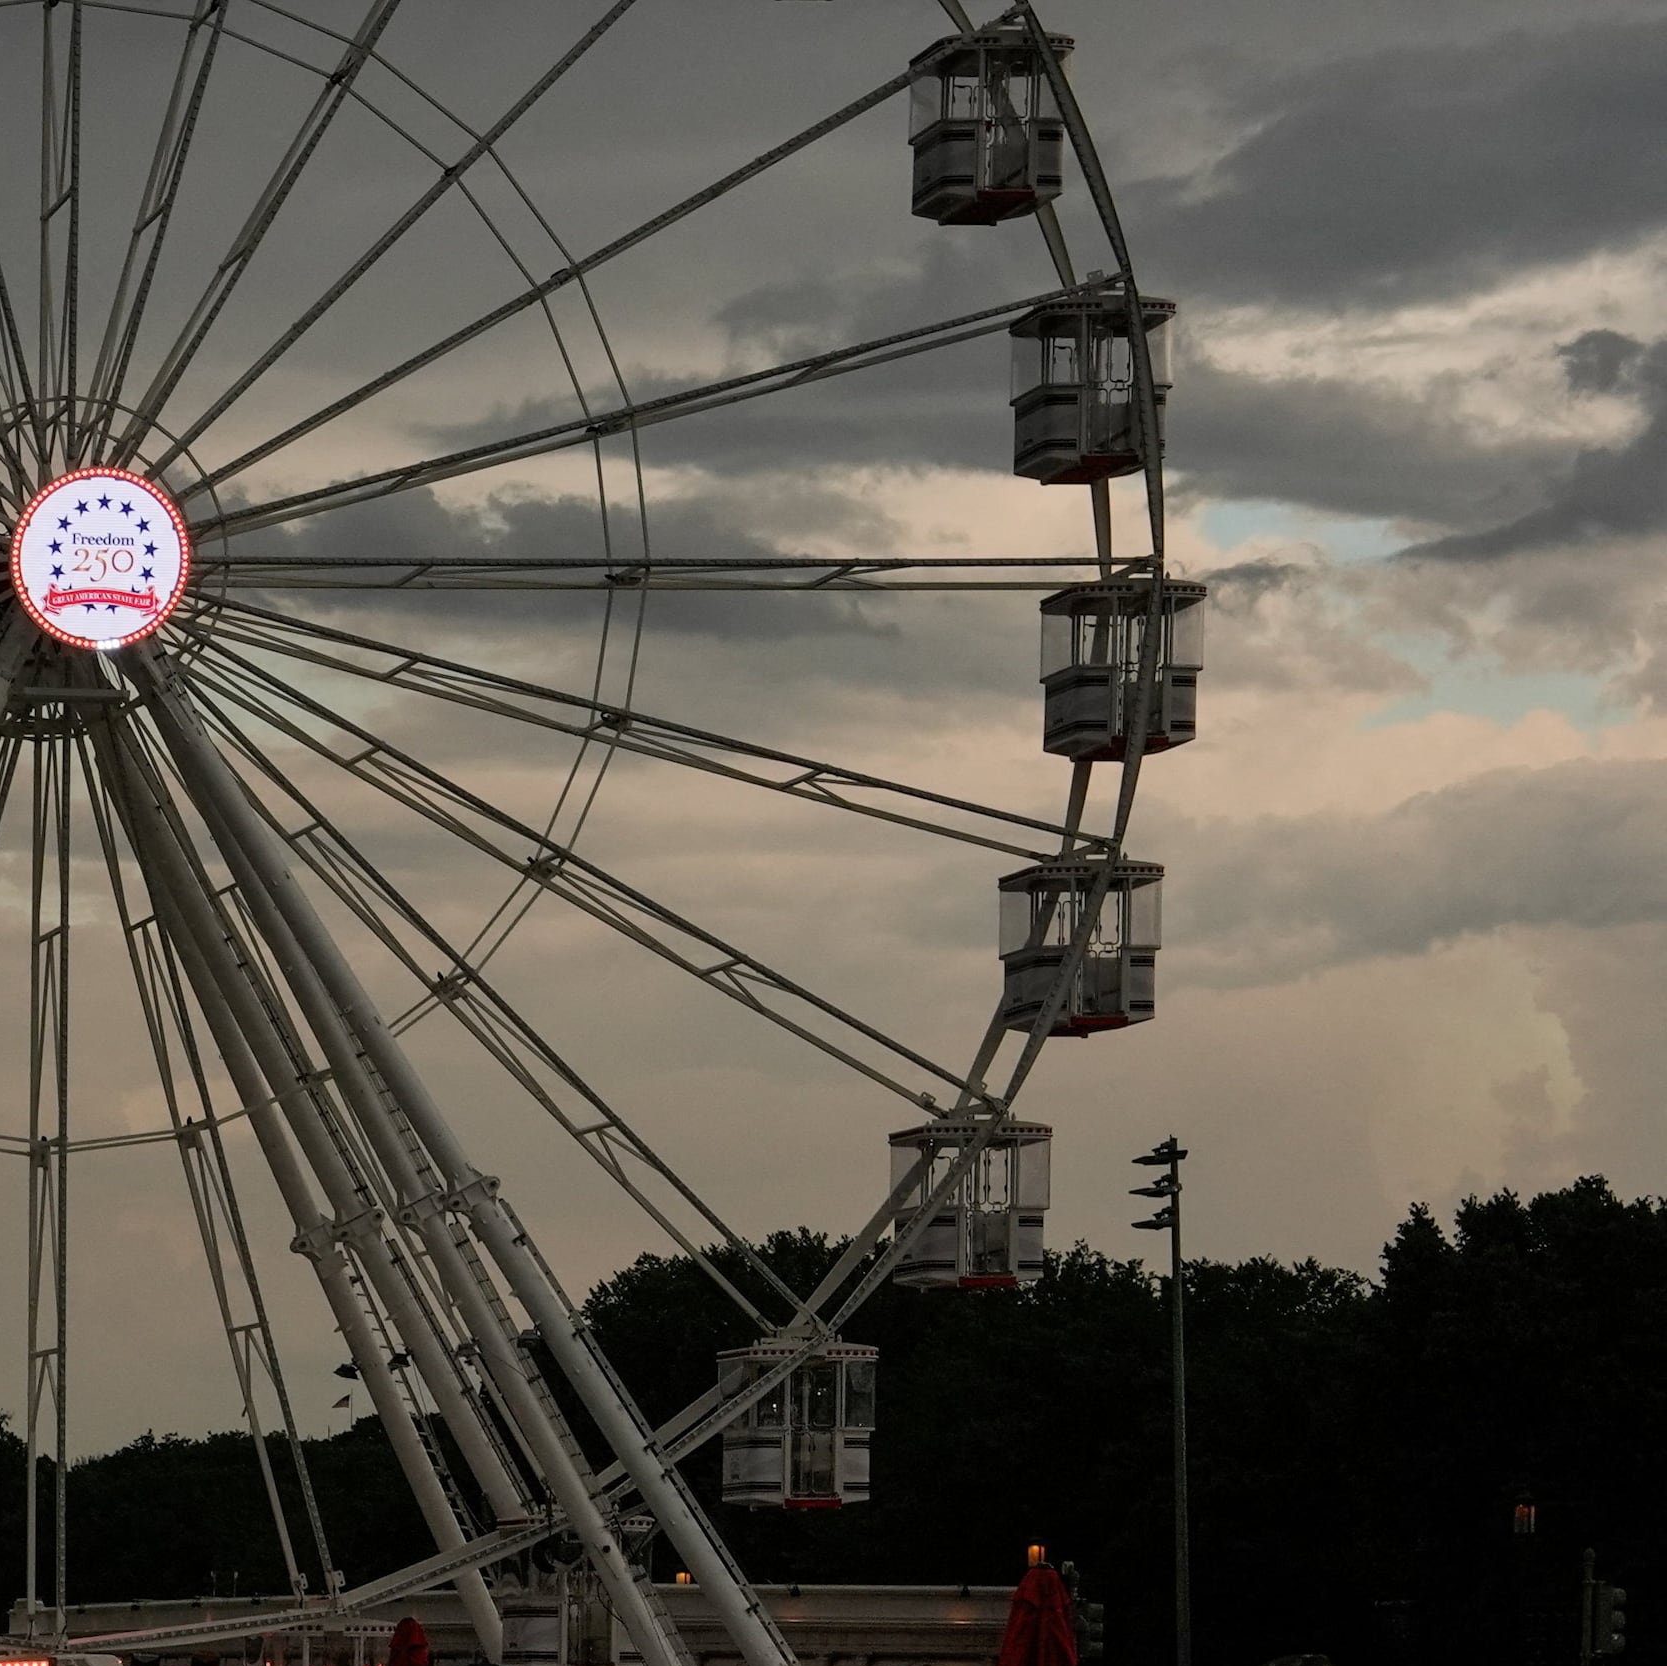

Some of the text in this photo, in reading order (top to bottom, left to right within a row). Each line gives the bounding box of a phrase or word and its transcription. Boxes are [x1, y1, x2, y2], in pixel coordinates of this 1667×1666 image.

[72, 532, 135, 546] Freedom
[71, 547, 134, 582] 250
[52, 592, 151, 606] GREAT AMERICAN STATE FAIR
